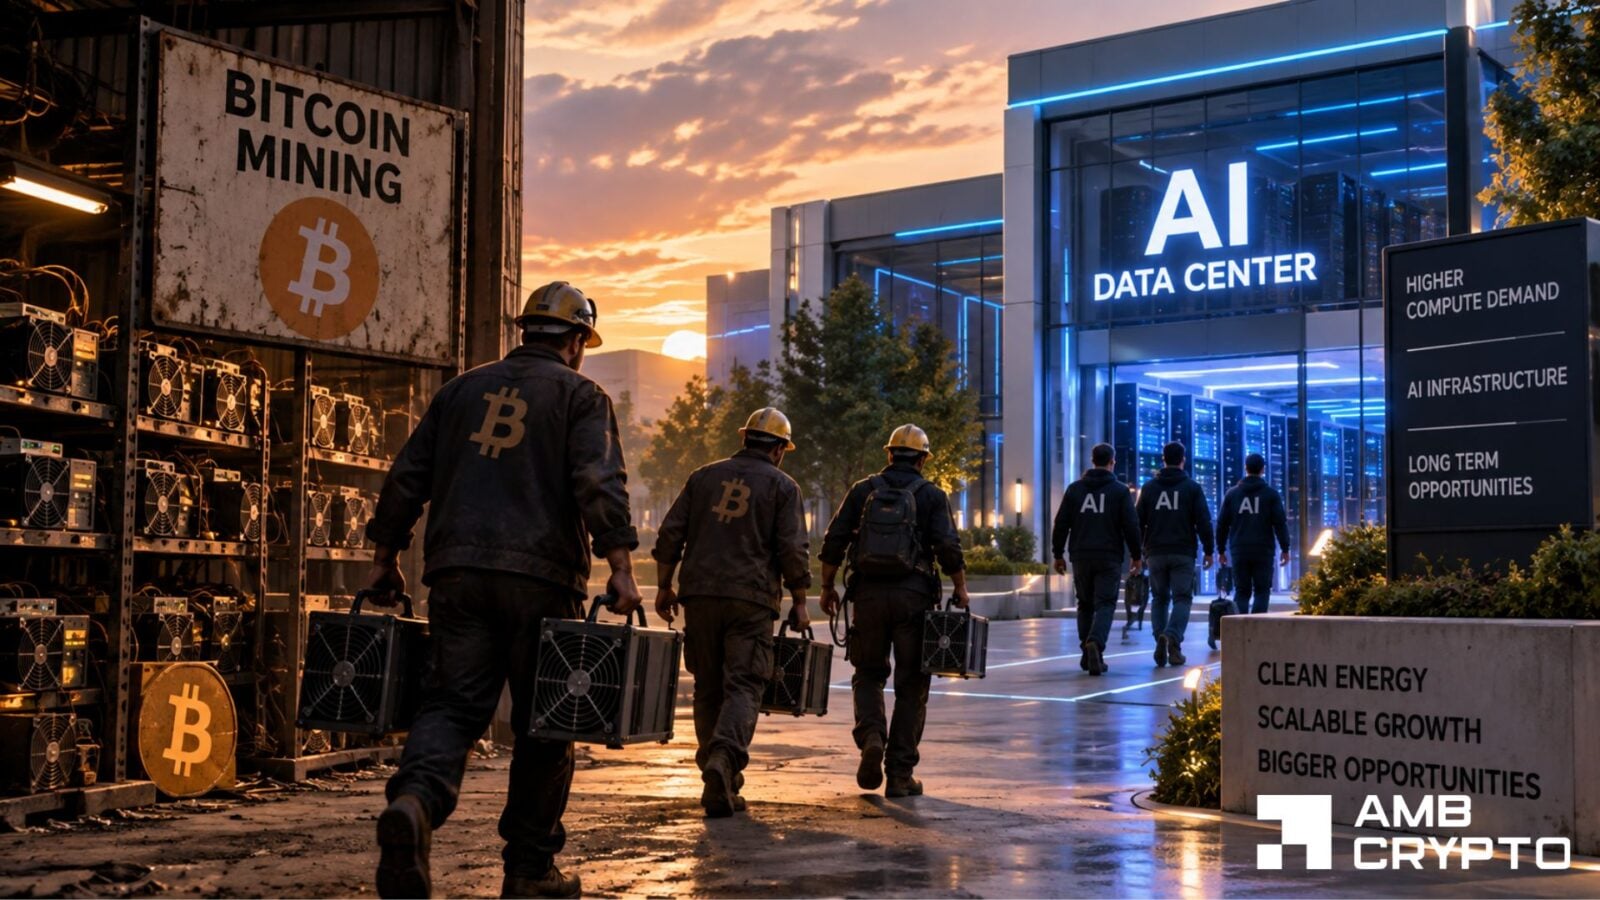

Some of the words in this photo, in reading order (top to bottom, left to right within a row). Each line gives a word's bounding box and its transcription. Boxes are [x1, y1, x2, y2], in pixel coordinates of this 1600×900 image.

[225, 69, 410, 157] BITCOIN
[236, 129, 402, 204] MINING
[1144, 161, 1249, 256] AI
[1094, 267, 1175, 301] DATA
[1184, 252, 1318, 292] CENTER
[1406, 268, 1464, 294] HIGHER
[1406, 292, 1482, 320] COMPUTE
[1487, 281, 1560, 309] DEMAND
[1407, 382, 1422, 399] AI
[1427, 366, 1568, 397] INFRASTRUCTURE
[1408, 454, 1451, 474] LONG
[1455, 450, 1499, 470] TERM
[1080, 493, 1105, 514] AI
[1155, 490, 1179, 511] AI
[1408, 476, 1534, 500] OPPORTUNITIES
[1238, 496, 1260, 515] AI
[1257, 661, 1328, 688] CLEAN
[1335, 664, 1429, 693] ENERGY
[1257, 705, 1368, 736] SCALABLE
[1374, 712, 1482, 744] GROWTH
[1257, 748, 1337, 780] BIGGER
[1344, 756, 1542, 801] OPPORTUNITIES
